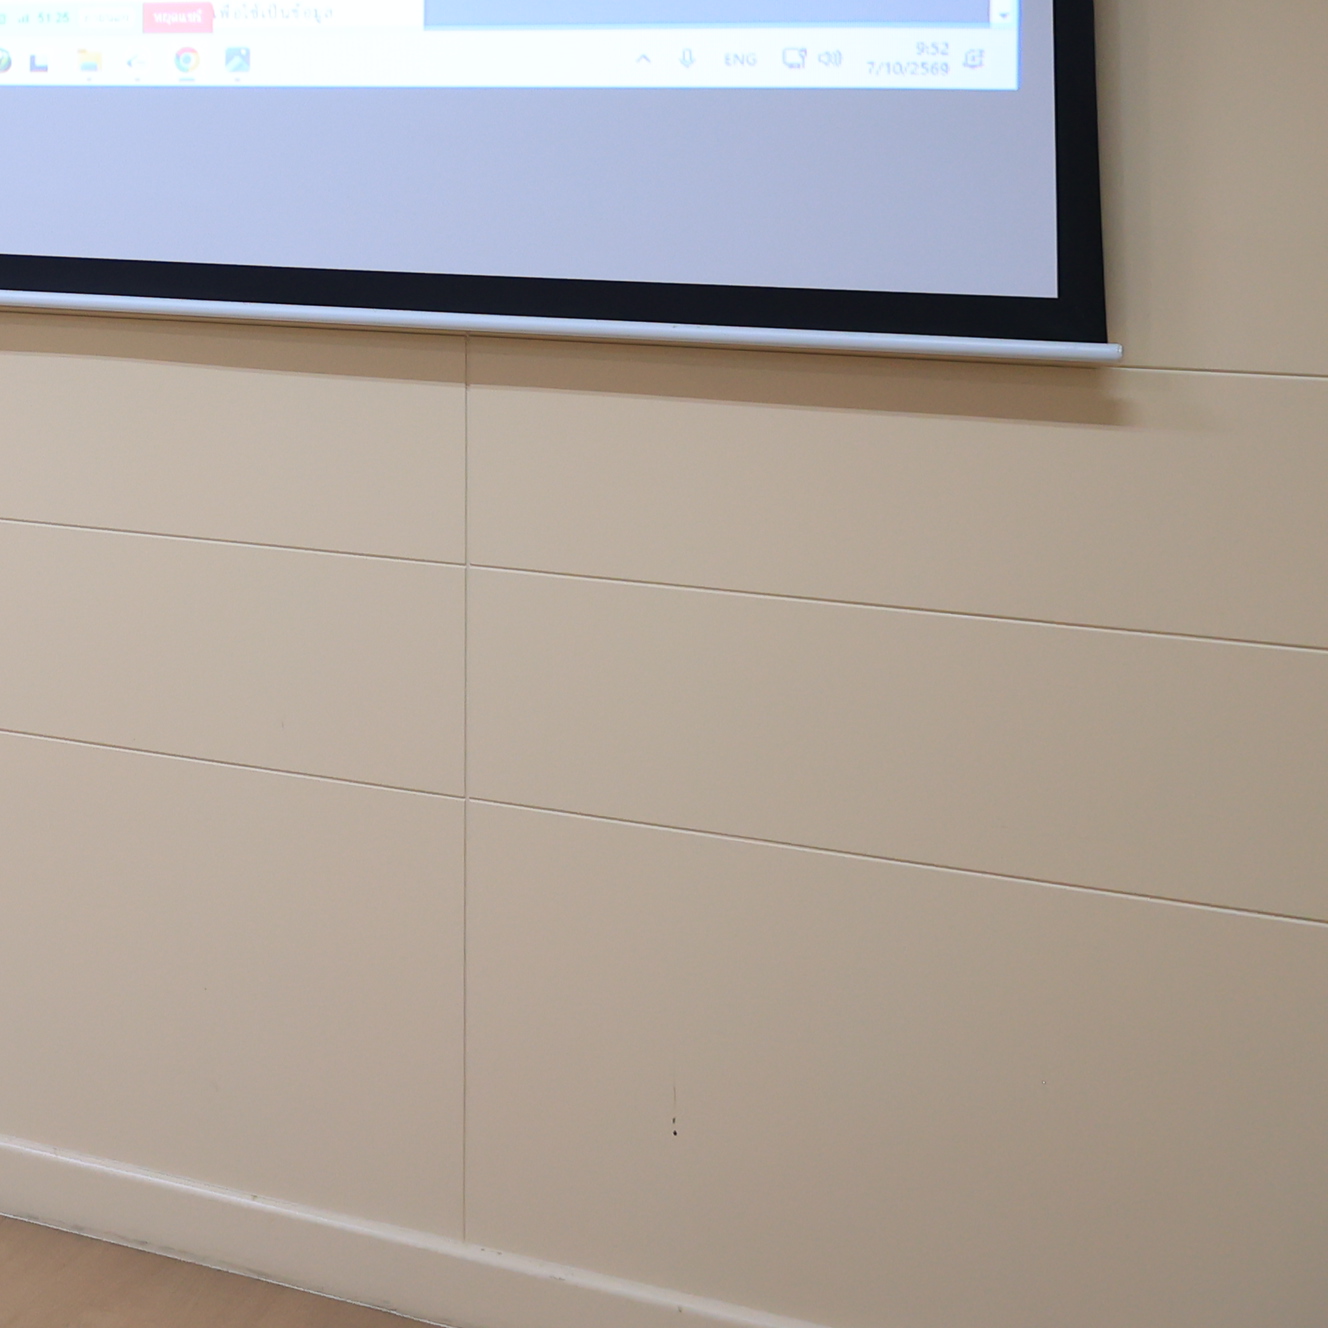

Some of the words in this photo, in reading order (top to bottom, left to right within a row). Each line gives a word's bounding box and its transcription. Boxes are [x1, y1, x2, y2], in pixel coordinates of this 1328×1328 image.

[914, 41, 951, 57] 9:52
[723, 52, 759, 67] ENG
[864, 60, 951, 77] 7/10/2569
